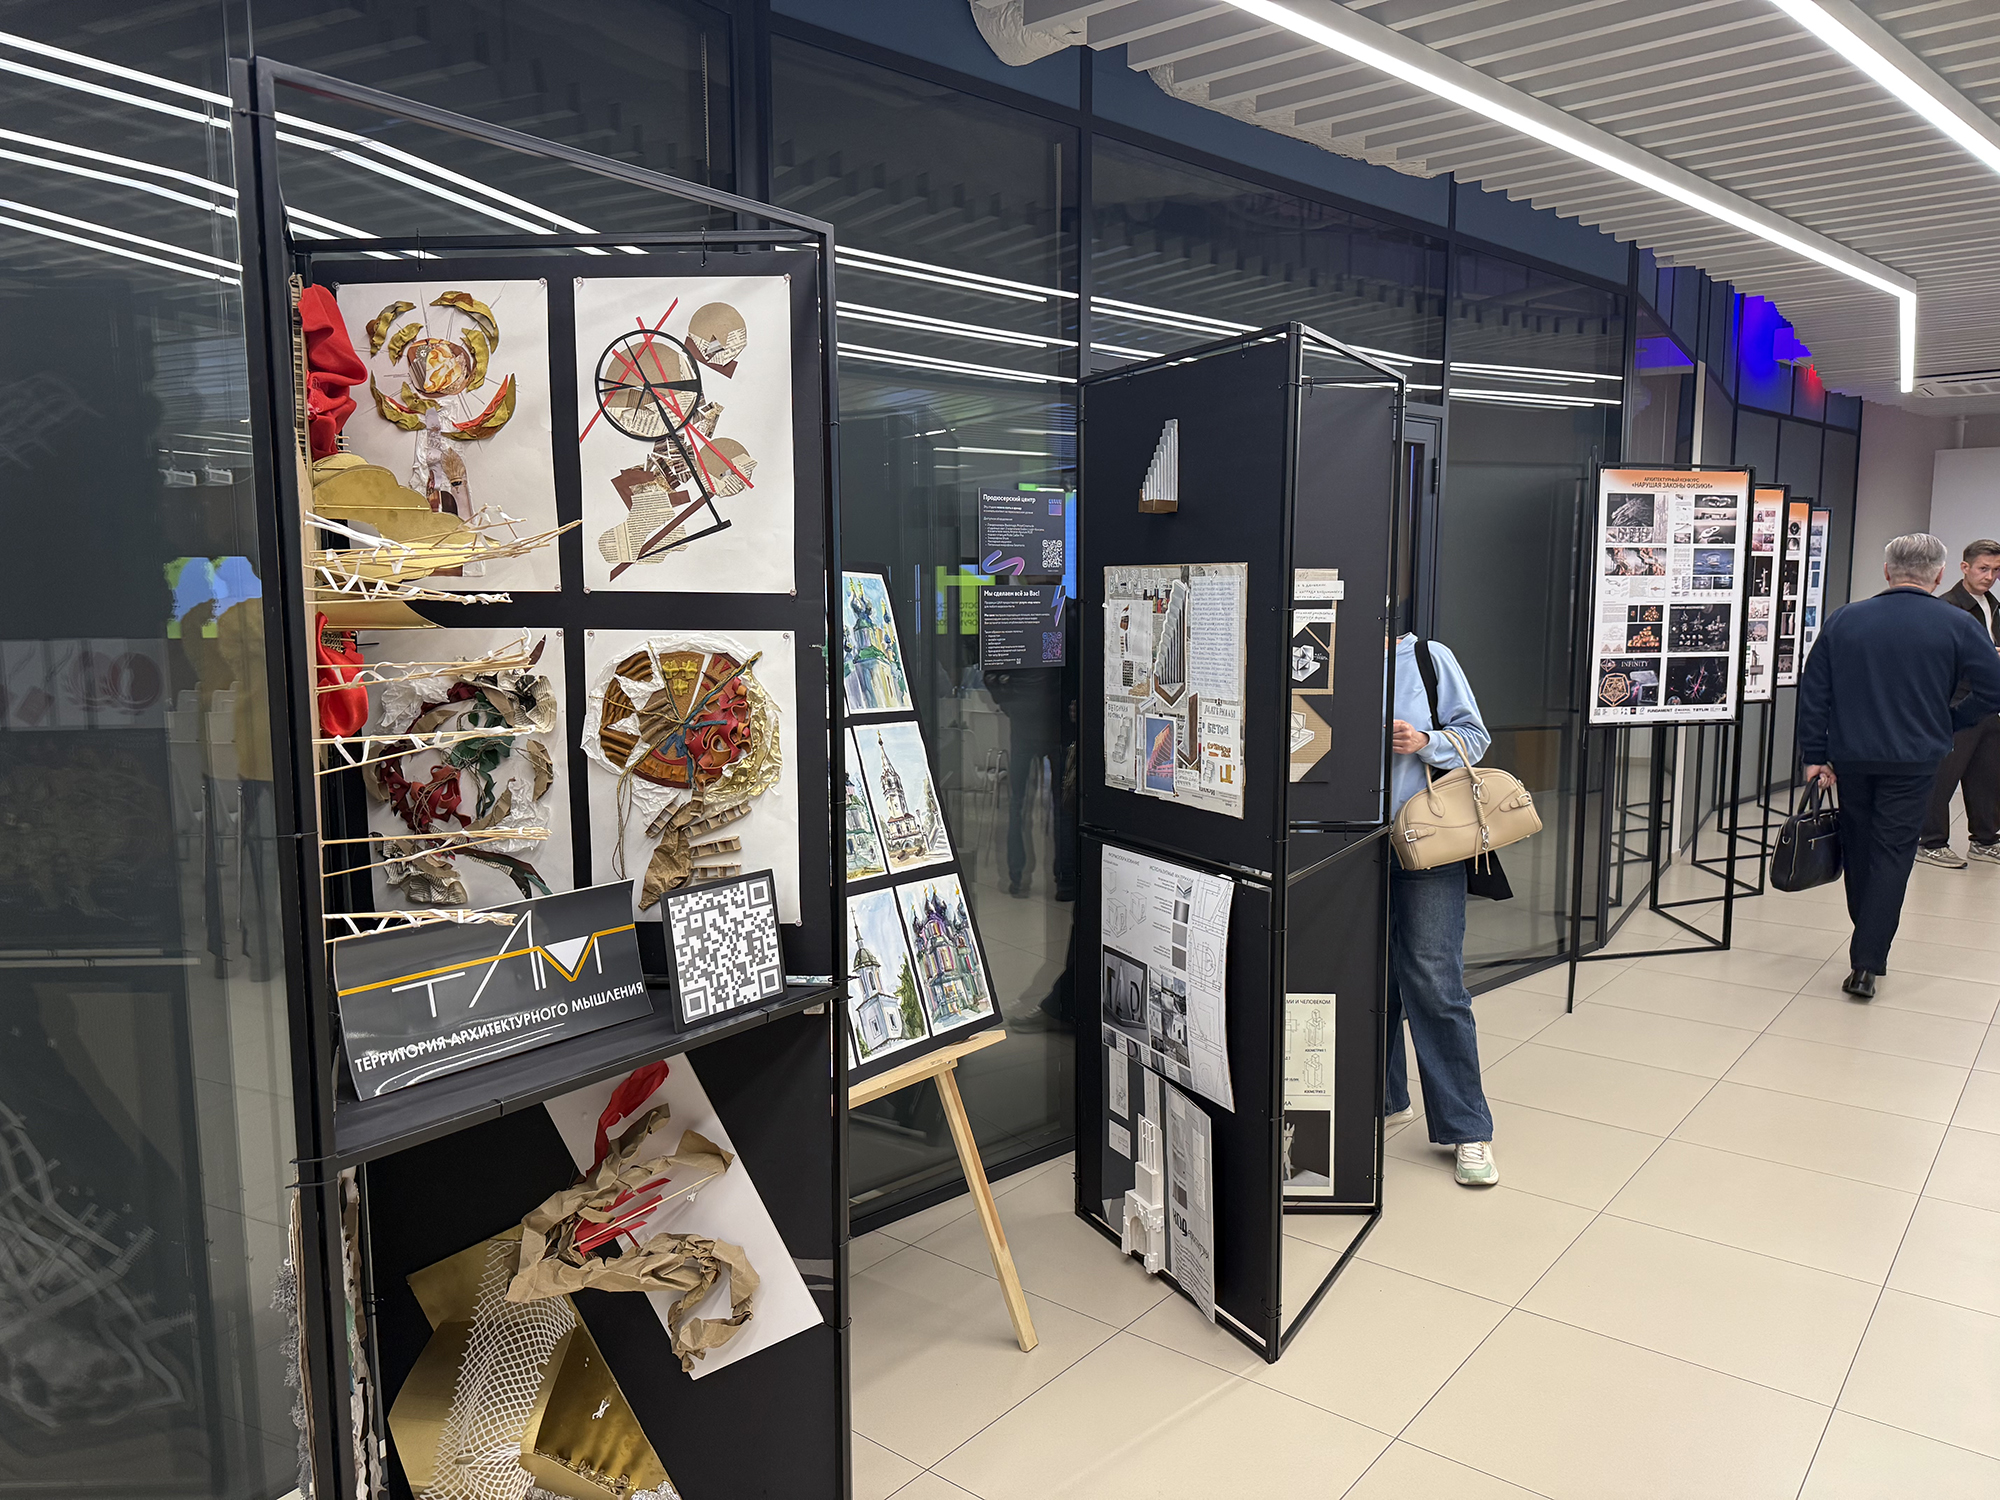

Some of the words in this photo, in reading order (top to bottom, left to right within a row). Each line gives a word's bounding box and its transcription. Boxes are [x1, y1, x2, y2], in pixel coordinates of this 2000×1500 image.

[982, 493, 1021, 503] Продюсерский
[354, 1034, 446, 1073] ТЕРРИТОРИЯ
[449, 1002, 569, 1048] АРХИТЕКТУРНОГО
[571, 981, 645, 1012] МЫШЛЕНИЯ
